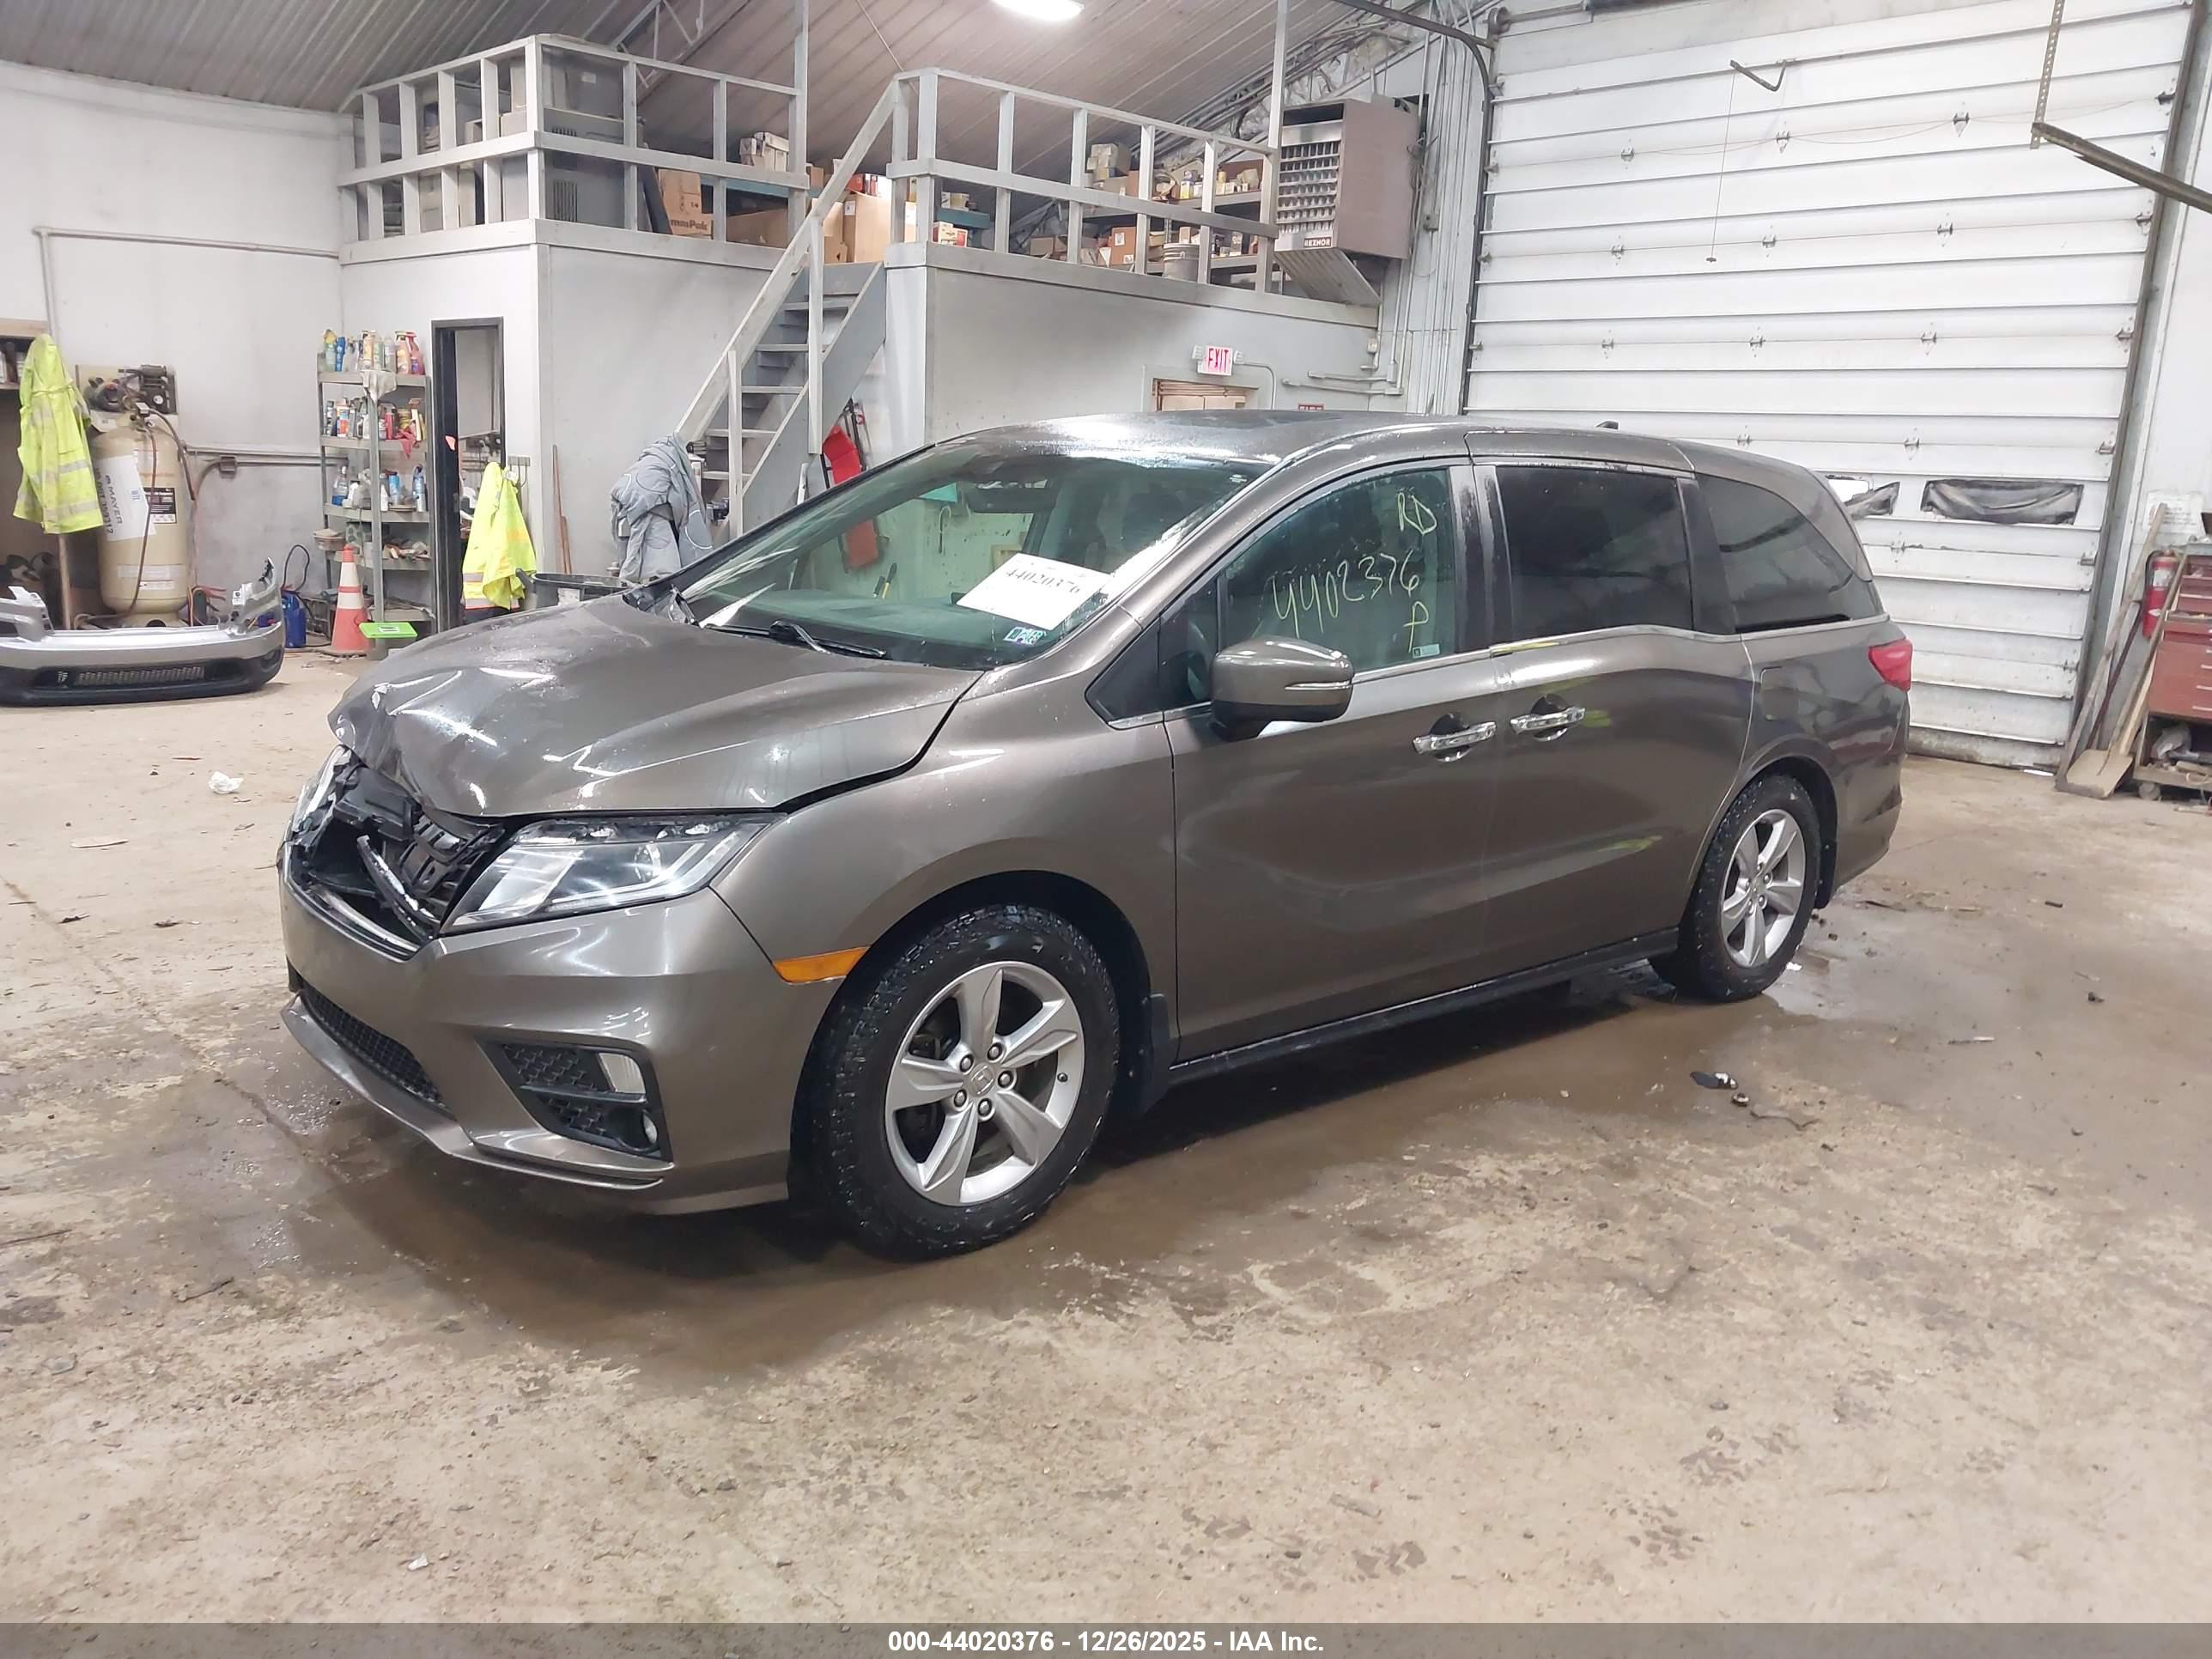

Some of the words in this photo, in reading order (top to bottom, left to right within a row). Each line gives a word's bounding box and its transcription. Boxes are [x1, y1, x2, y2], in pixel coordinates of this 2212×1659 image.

[1304, 239, 1330, 247] REZNOR
[1208, 348, 1229, 373] EXIT
[1397, 492, 1437, 535] RD
